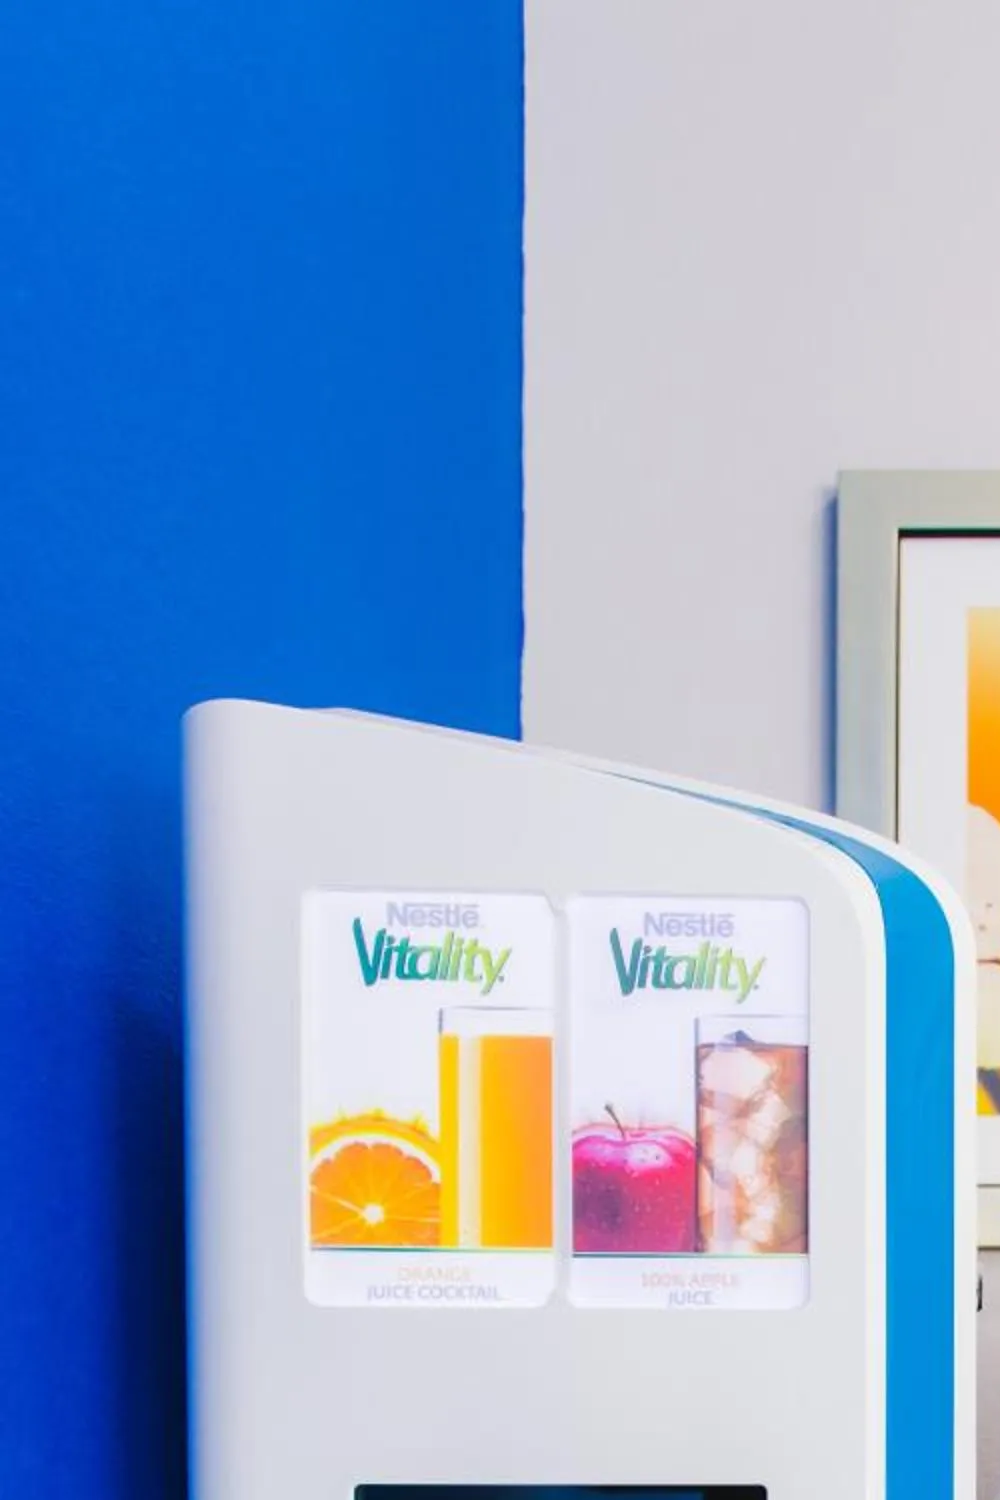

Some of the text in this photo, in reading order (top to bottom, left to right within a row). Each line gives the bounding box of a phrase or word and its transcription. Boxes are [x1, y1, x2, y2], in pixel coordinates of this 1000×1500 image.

[352, 916, 513, 996] Vitality
[609, 927, 767, 1004] Vitality
[641, 1272, 740, 1289] 100% APPLE
[367, 1284, 499, 1301] JUICE COCKTAIL
[667, 1290, 714, 1306] JUICE
